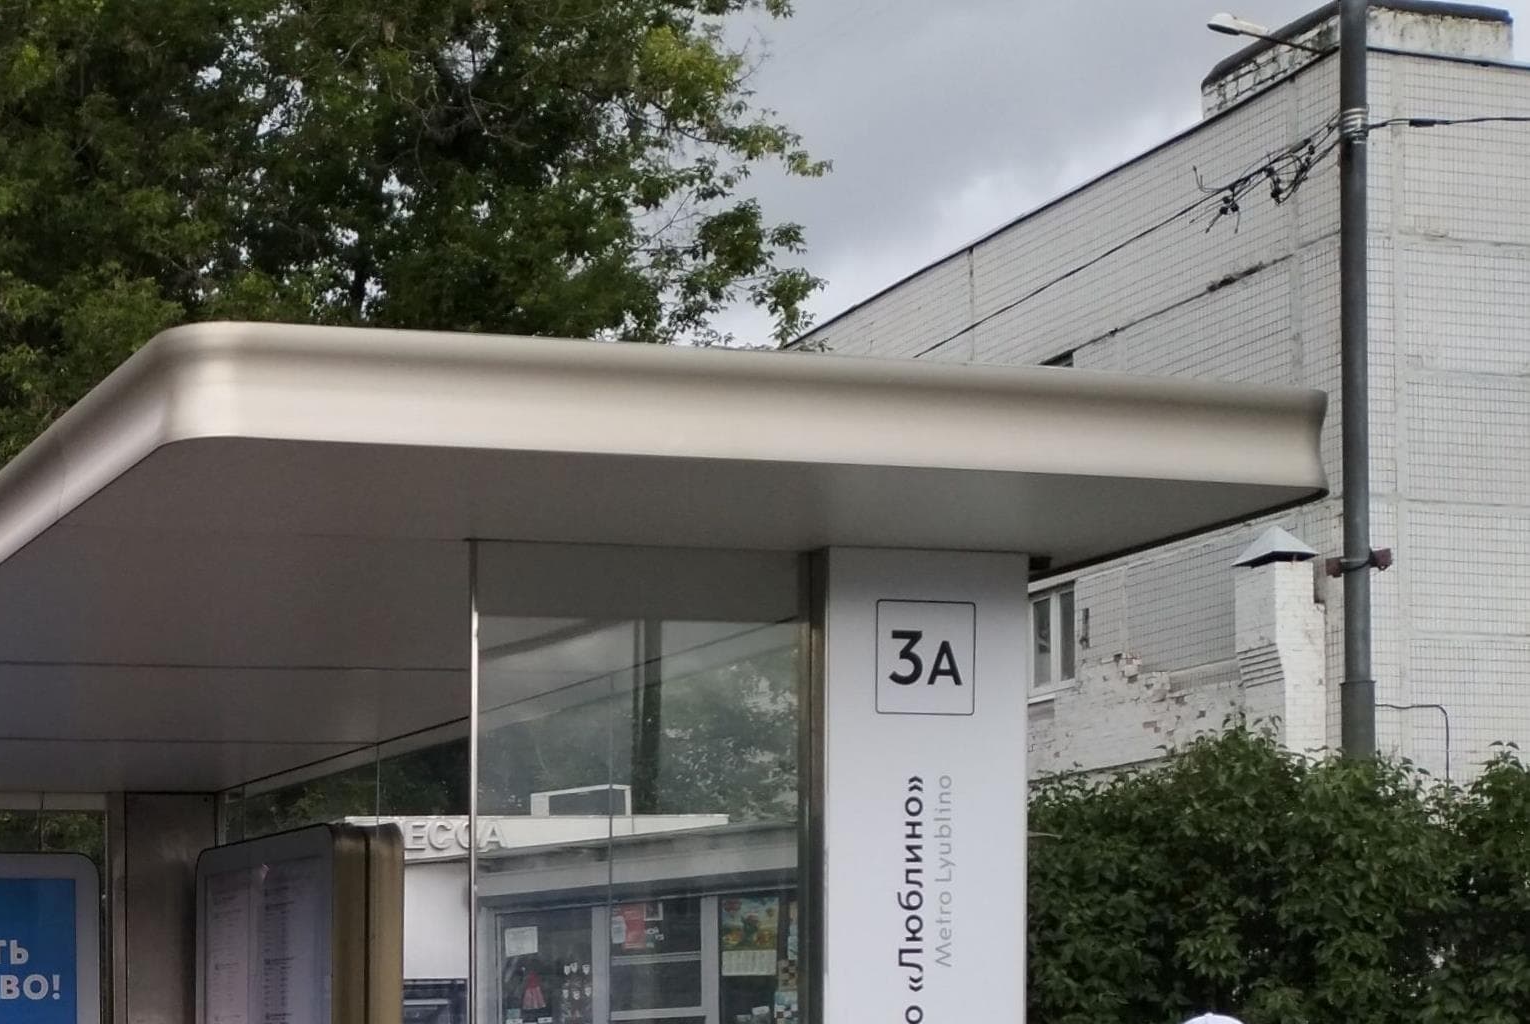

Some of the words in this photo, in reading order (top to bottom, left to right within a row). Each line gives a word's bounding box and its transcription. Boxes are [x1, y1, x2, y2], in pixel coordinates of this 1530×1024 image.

[934, 774, 957, 882] Lyublino
[897, 774, 925, 994] «Люблино»
[934, 891, 953, 968] Metro
